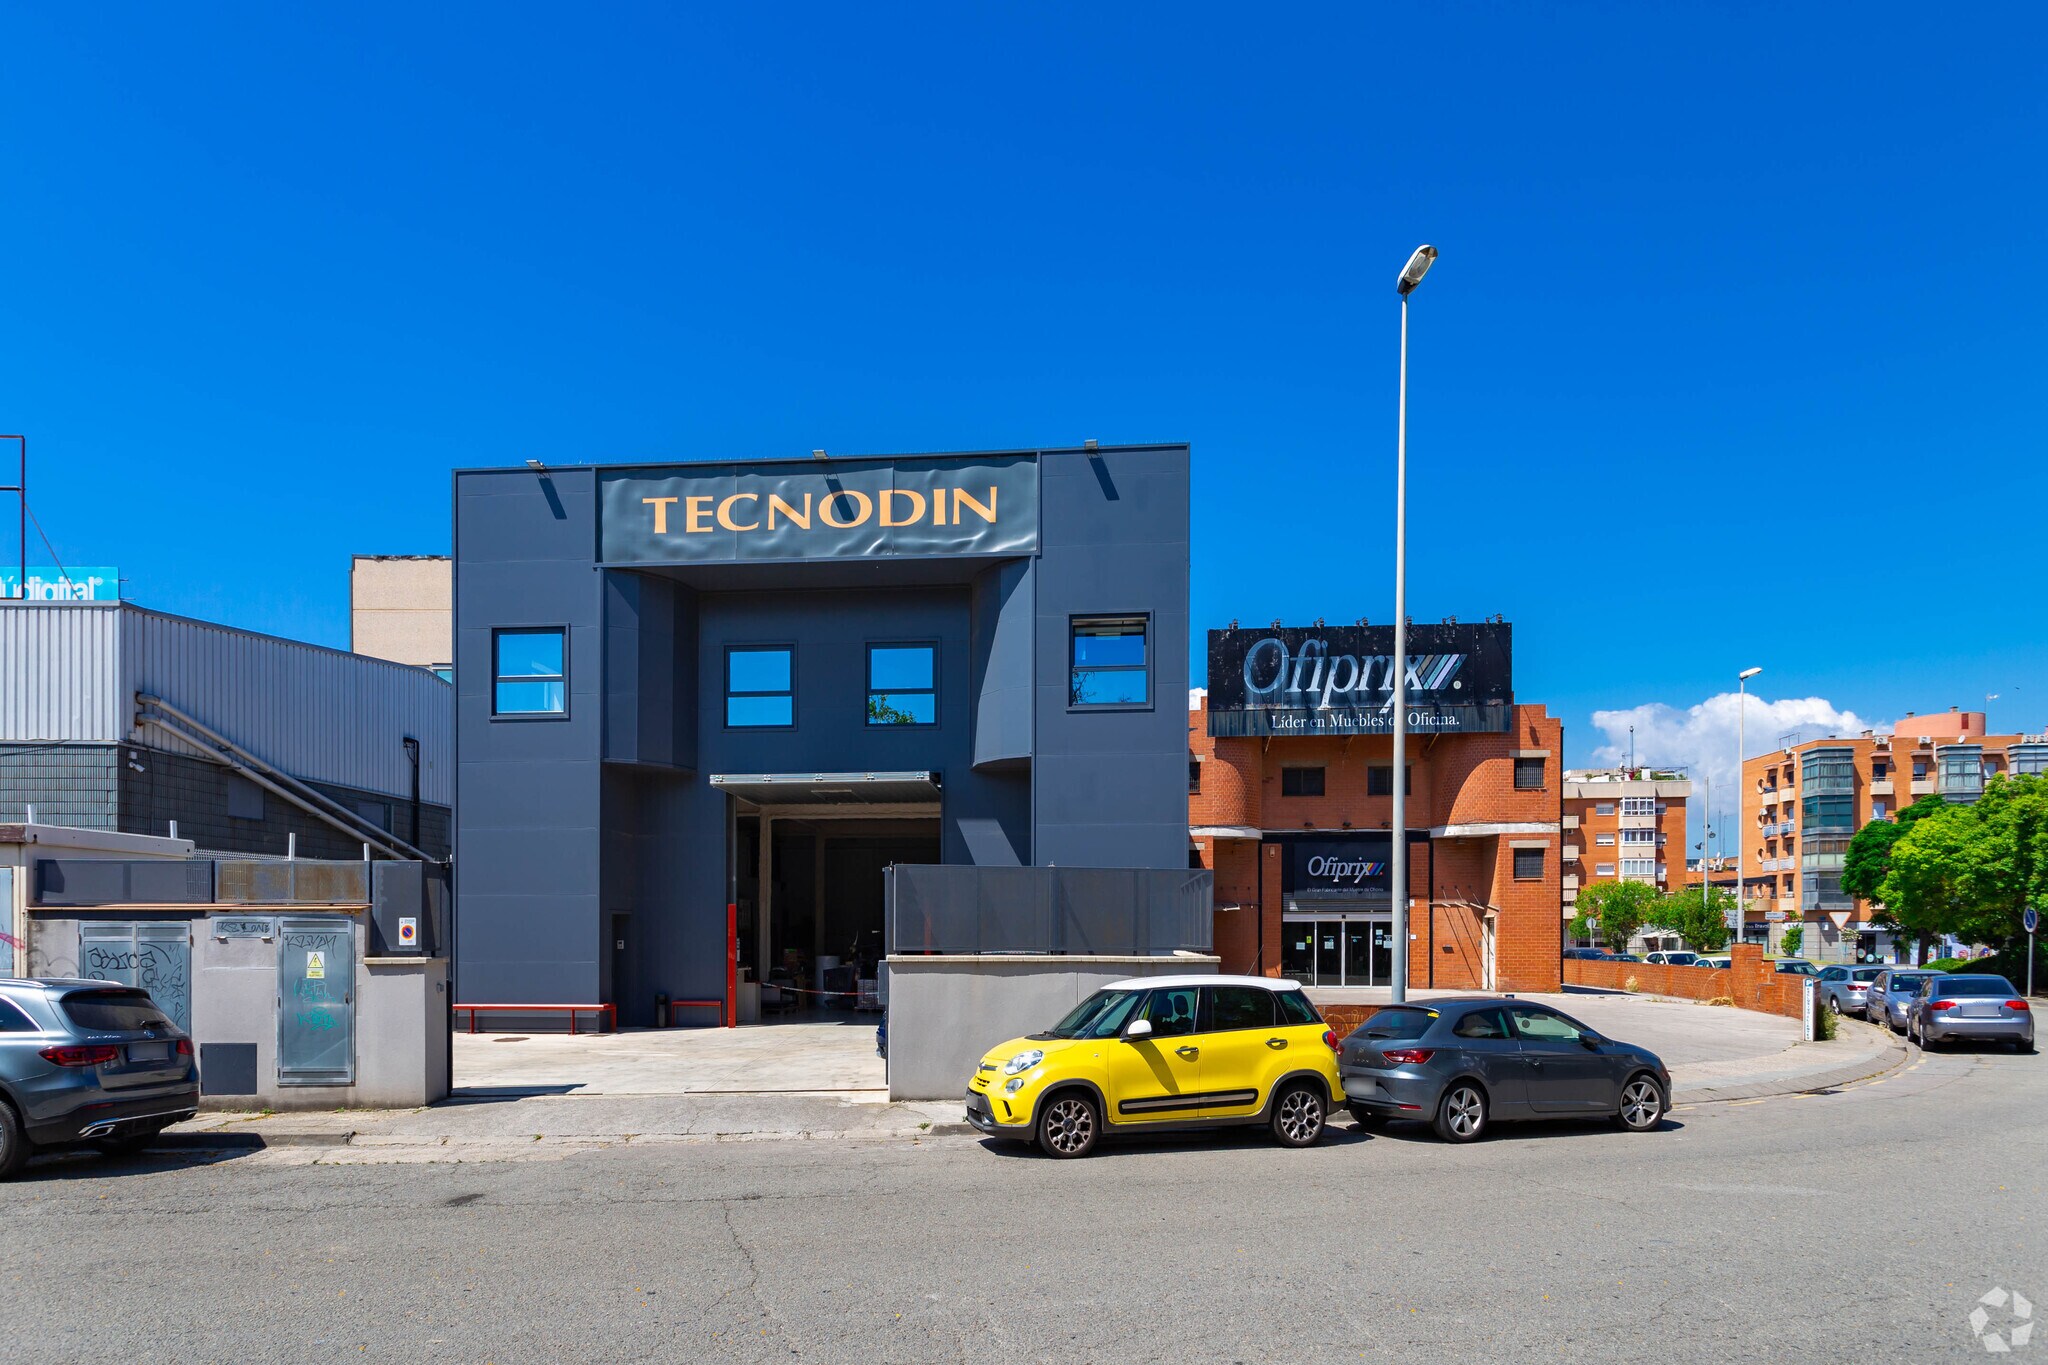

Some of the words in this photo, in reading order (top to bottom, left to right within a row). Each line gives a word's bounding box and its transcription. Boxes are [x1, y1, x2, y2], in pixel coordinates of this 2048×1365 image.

[642, 486, 998, 534] TECNODIN
[1243, 637, 1426, 714] Ofiprix
[1272, 715, 1307, 728] Líder
[1310, 718, 1325, 728] en
[1329, 714, 1384, 728] Muebles
[1307, 856, 1371, 883] Ofiprix
